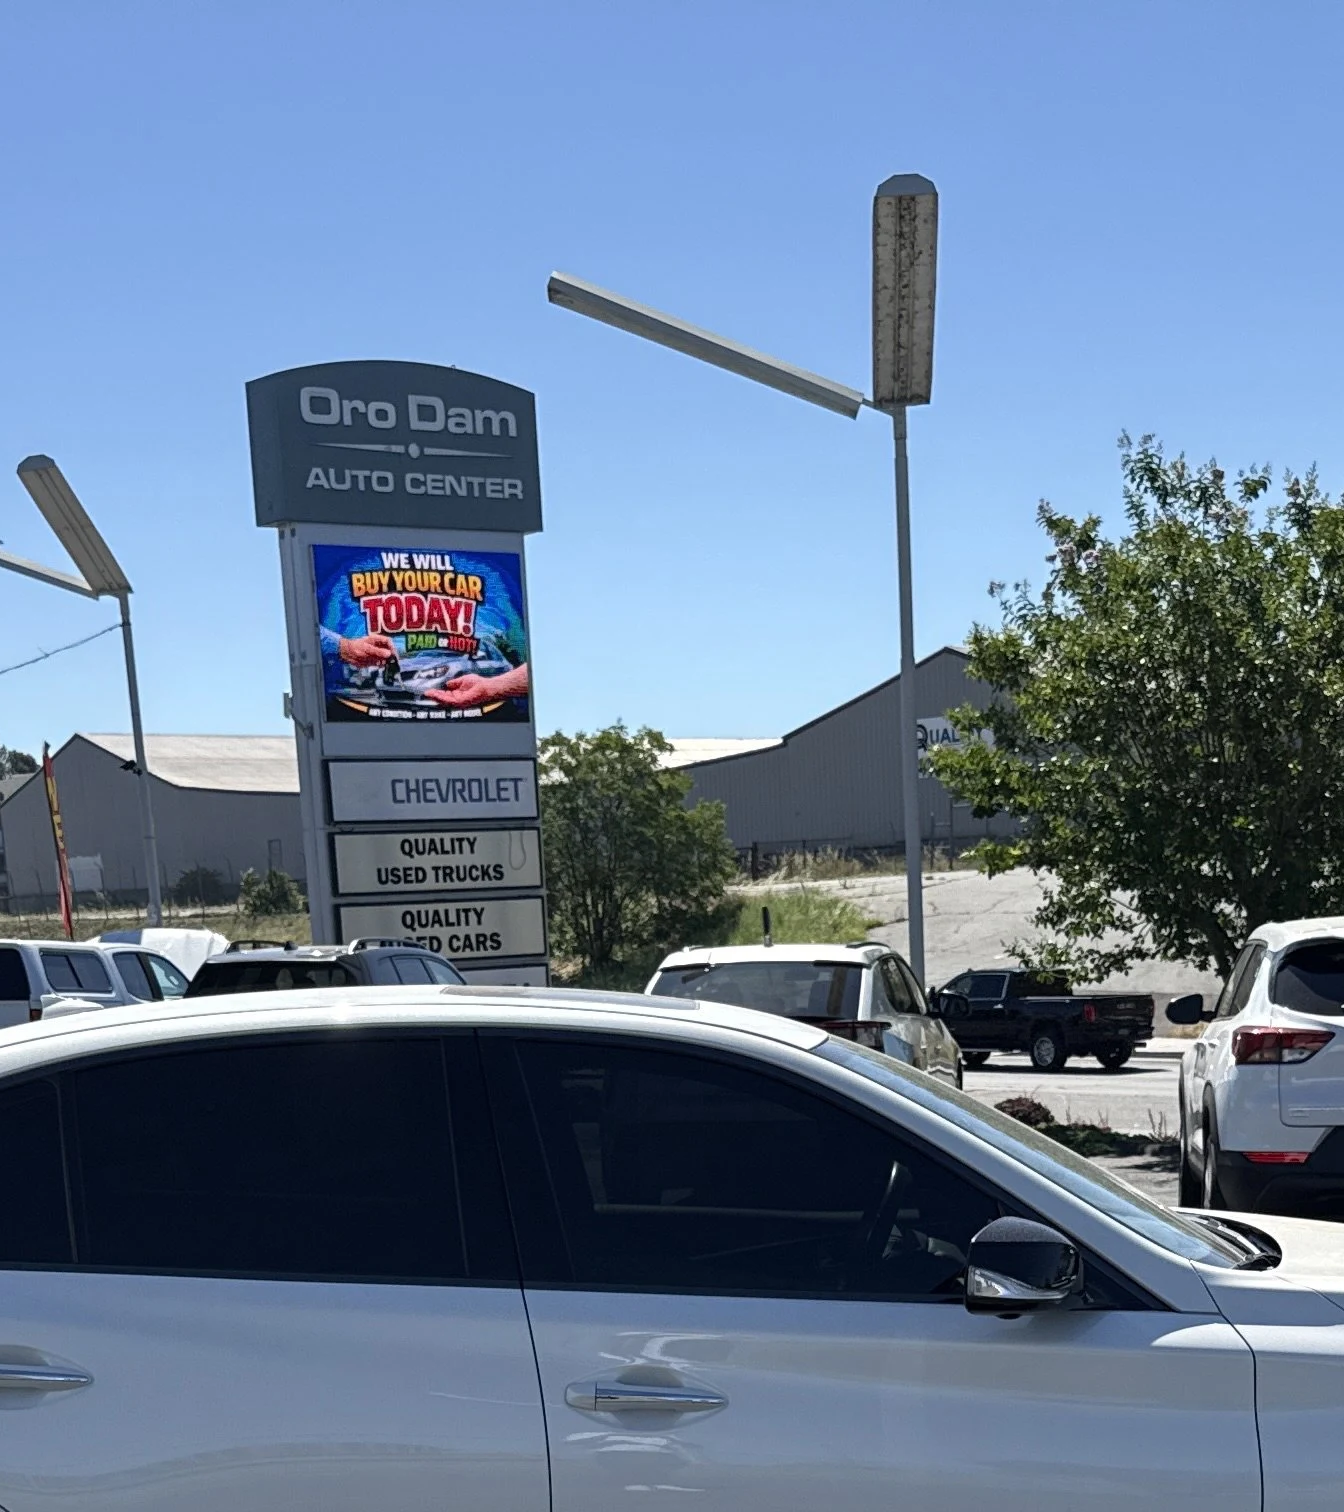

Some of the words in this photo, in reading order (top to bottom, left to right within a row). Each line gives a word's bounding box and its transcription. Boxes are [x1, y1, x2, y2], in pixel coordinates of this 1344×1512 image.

[300, 387, 396, 428] Oro
[408, 394, 517, 437] Dam
[306, 467, 394, 493] AUTO
[405, 473, 523, 499] CENTER
[381, 553, 410, 569] WE
[413, 554, 454, 570] WILL
[352, 571, 391, 596] BUY
[391, 570, 443, 593] YOUR
[443, 573, 482, 600] CAR
[360, 594, 476, 636] TODAY!
[408, 633, 437, 649] PAID
[391, 777, 524, 804] CHEVROLET
[400, 837, 477, 858] QUALITY
[377, 867, 427, 885] USED
[432, 864, 504, 882] TRUCKS
[401, 907, 485, 932] QUALITY
[448, 932, 502, 953] CARS
